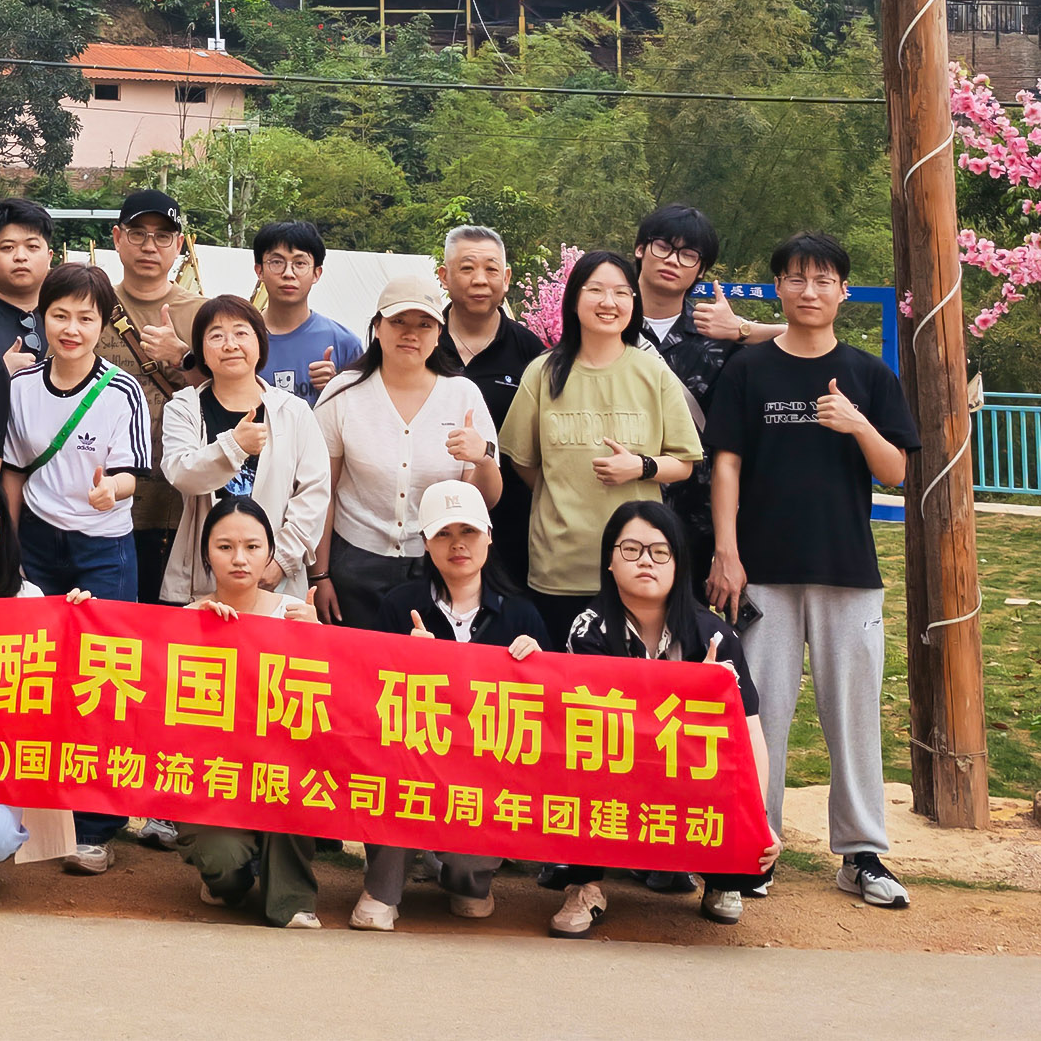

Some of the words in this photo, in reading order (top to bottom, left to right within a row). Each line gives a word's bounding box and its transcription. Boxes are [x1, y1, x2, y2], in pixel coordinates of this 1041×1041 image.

[764, 402, 807, 411] FIND
[375, 668, 729, 781] 砥砺前行
